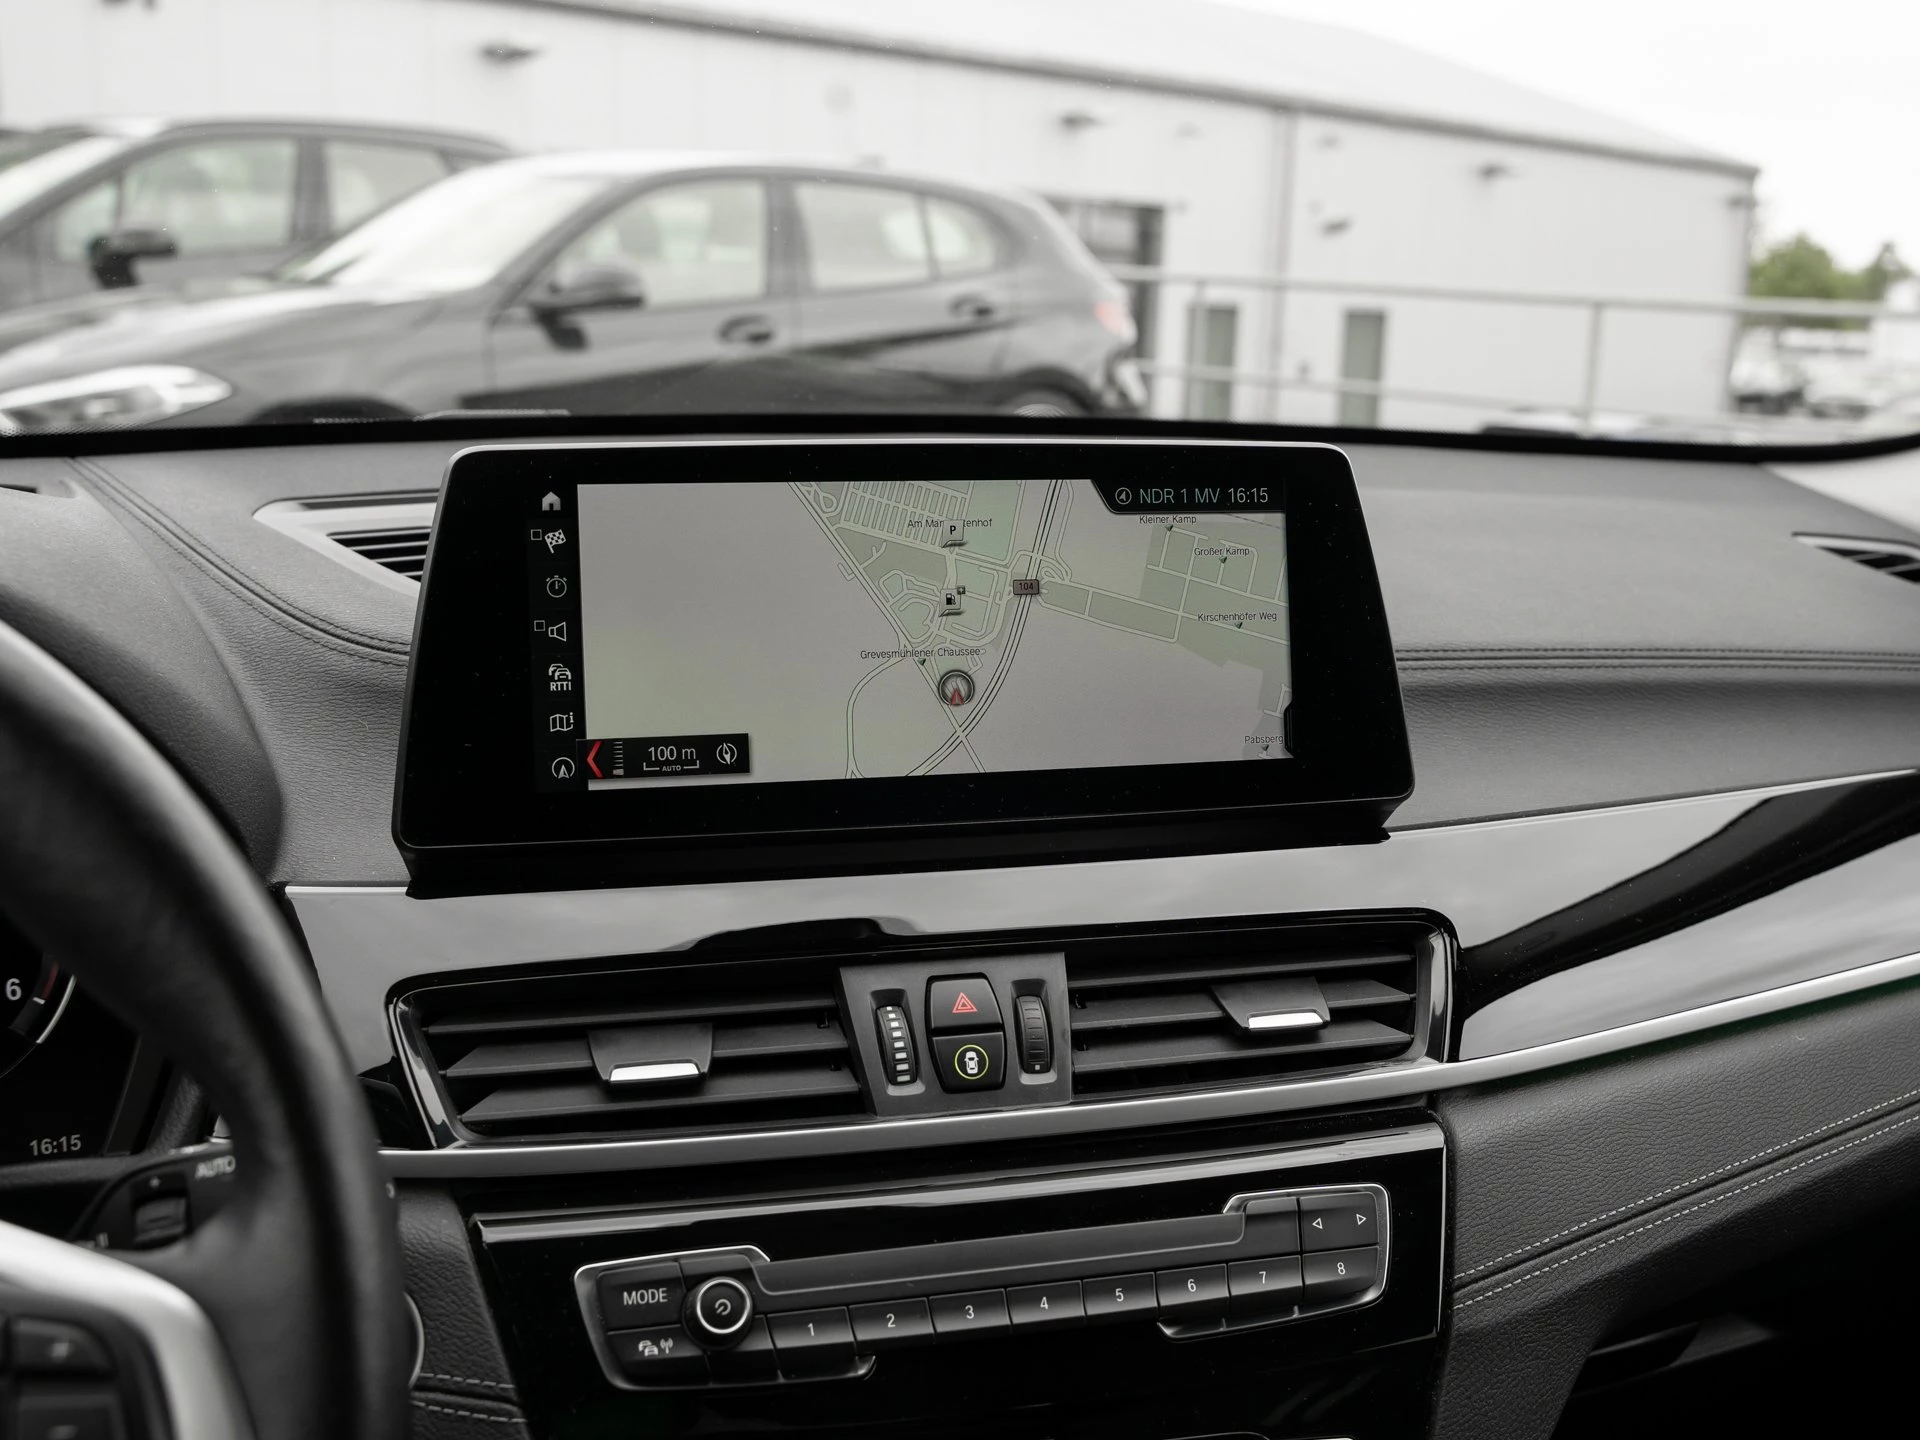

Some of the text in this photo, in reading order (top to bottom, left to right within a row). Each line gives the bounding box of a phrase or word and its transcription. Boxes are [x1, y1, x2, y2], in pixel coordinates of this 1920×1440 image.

[1139, 487, 1269, 504] NDR 1 MV 16:15
[908, 519, 923, 528] Am
[1139, 515, 1197, 525] Kleiner Kamp
[1194, 547, 1250, 556] Großer Kamp
[1018, 582, 1034, 591] 104
[1198, 612, 1278, 622] Kirschenhöfer Weg
[860, 648, 981, 659] Grevesmühlener Chaussee
[550, 681, 572, 691] RTTI
[1244, 735, 1284, 744] Pabsberg
[648, 745, 696, 761] 100 m
[661, 764, 682, 772] AUTO
[5, 978, 22, 1000] 6
[29, 1134, 82, 1156] 16:15
[1336, 1261, 1346, 1276] 8
[1187, 1278, 1197, 1293] 6
[1258, 1271, 1267, 1285] 7
[623, 1287, 668, 1306] MODE
[1115, 1287, 1125, 1303] 5
[1039, 1295, 1050, 1311] 4
[965, 1304, 975, 1320] 3
[886, 1313, 896, 1329] 2
[807, 1322, 815, 1338] 1
